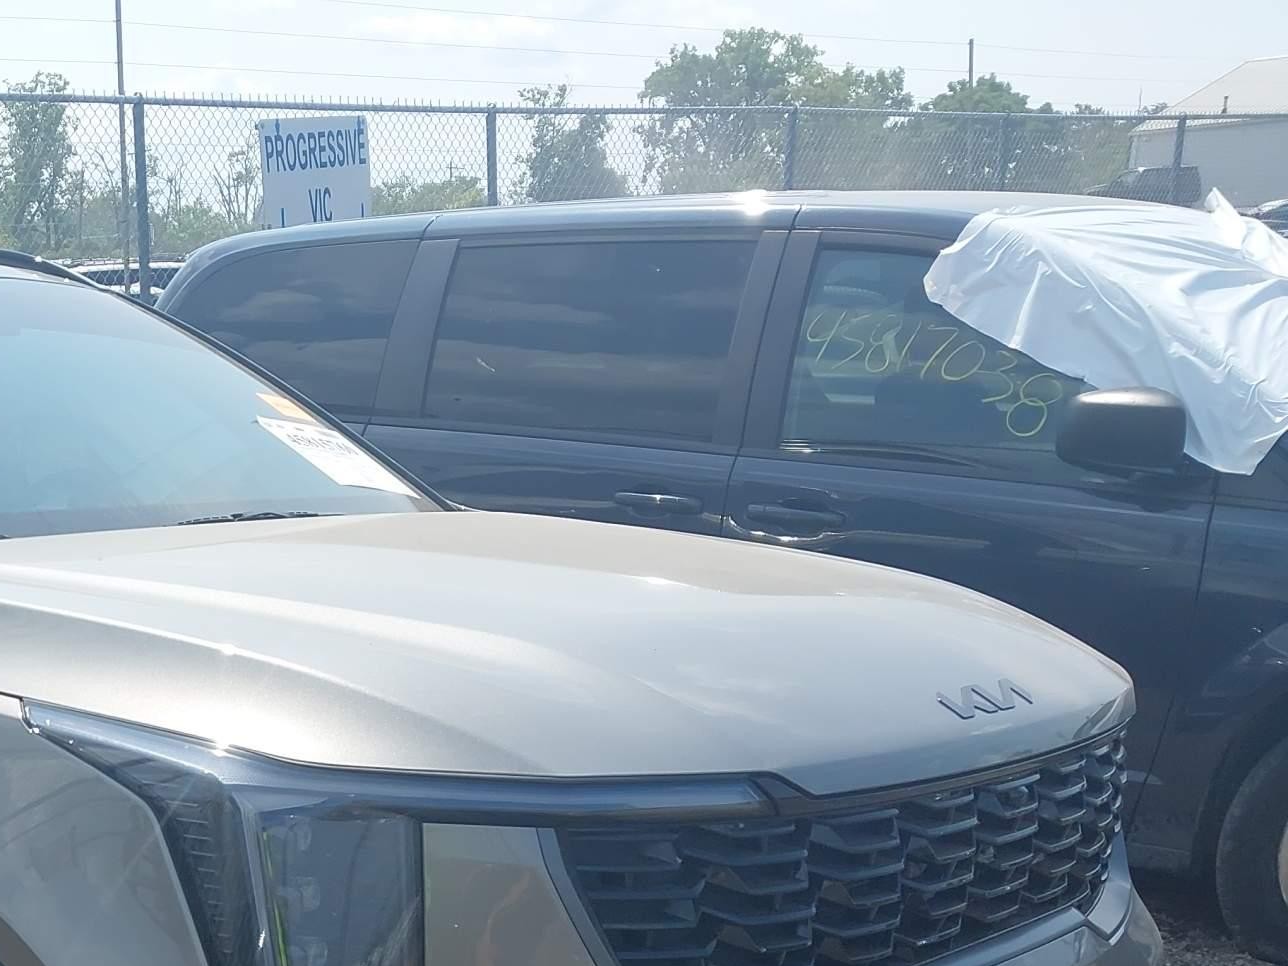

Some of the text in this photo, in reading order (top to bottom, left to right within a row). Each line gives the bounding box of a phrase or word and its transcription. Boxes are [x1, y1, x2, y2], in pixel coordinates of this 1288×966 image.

[264, 128, 367, 173] PROGRESSIVE
[308, 187, 333, 222] VIC
[936, 679, 1033, 720] KIA
